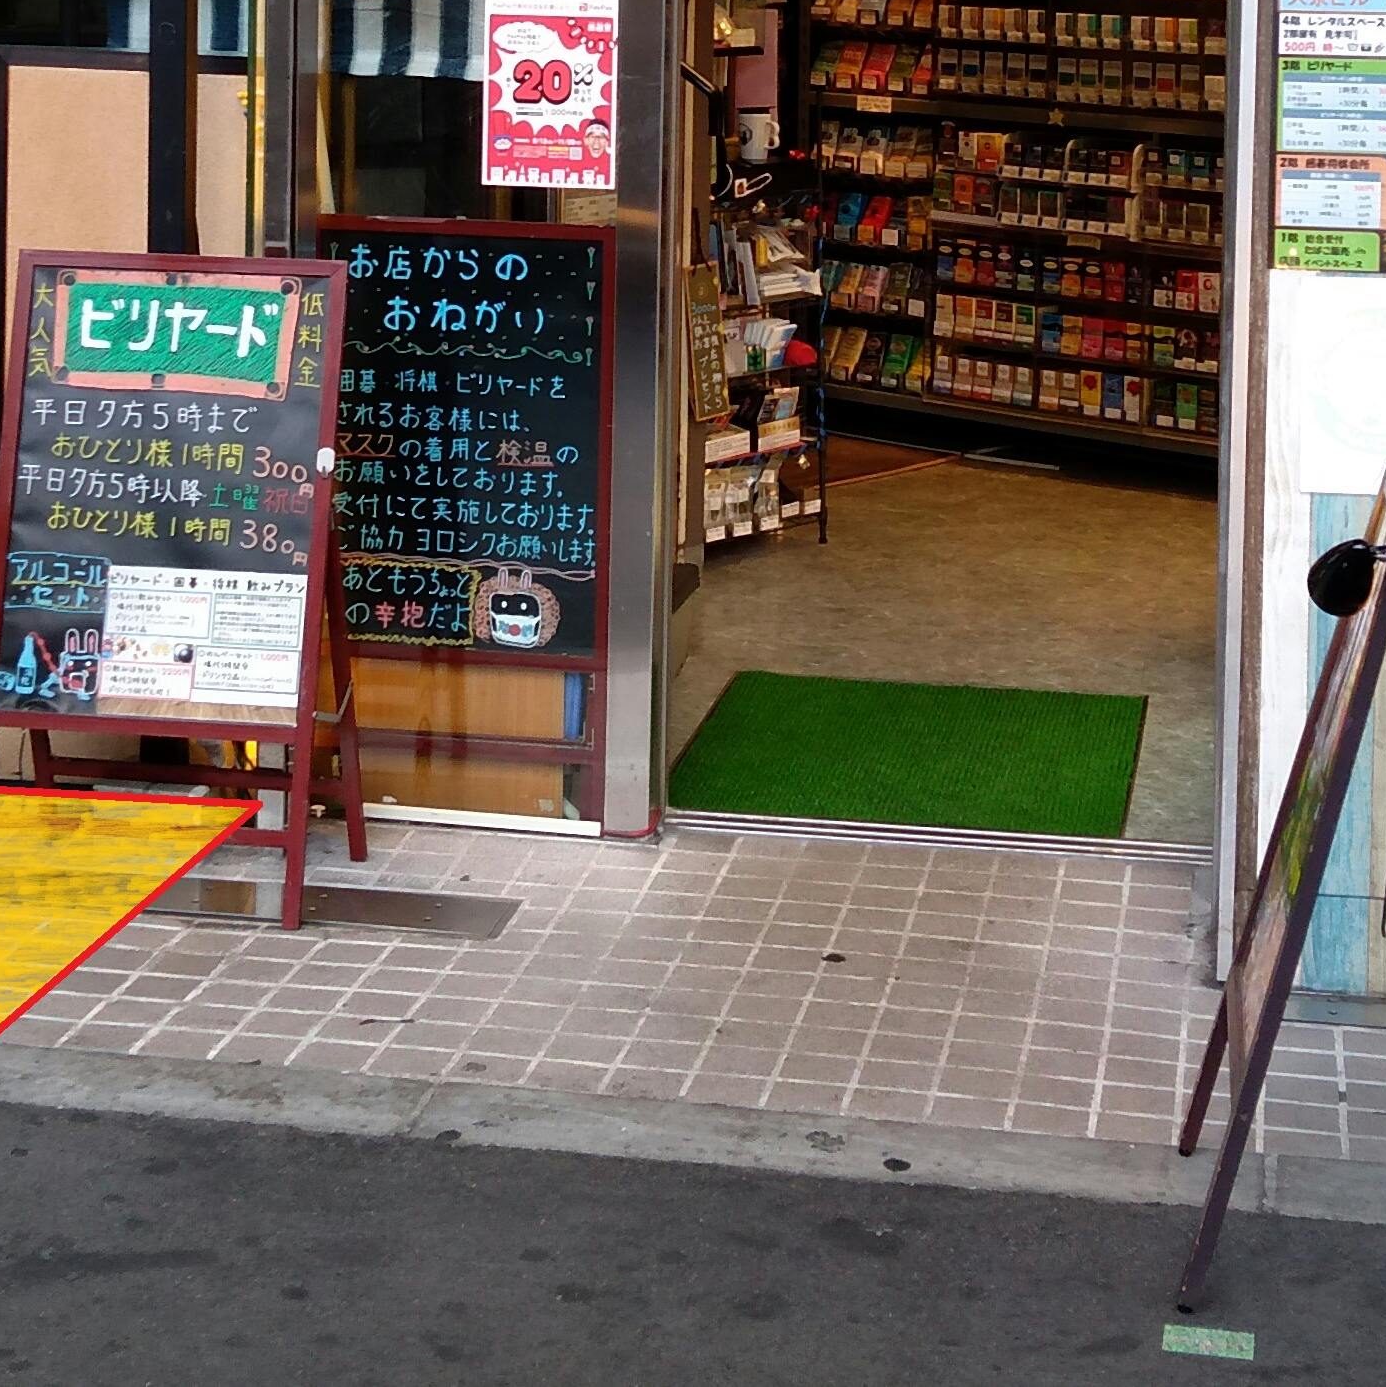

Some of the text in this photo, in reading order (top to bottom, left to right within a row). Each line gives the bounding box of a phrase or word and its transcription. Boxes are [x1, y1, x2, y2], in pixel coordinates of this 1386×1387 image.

[1308, 16, 1386, 28] レンタルスペース
[1306, 60, 1353, 71] ビリヤード
[348, 242, 531, 282] お店からの
[28, 281, 55, 380] 大人気
[80, 298, 279, 358] ビリヤード
[383, 294, 548, 335] おねがい
[297, 290, 326, 389] 低料金
[29, 398, 260, 434] 平日夕方5時まで
[337, 432, 580, 469] マスクの着用と検温の
[17, 462, 207, 508] 平日夕方5時以降
[334, 457, 565, 499] お願いをしております。
[332, 491, 597, 537] 受付にて実施しております。
[344, 599, 470, 633] の辛抱だよ
